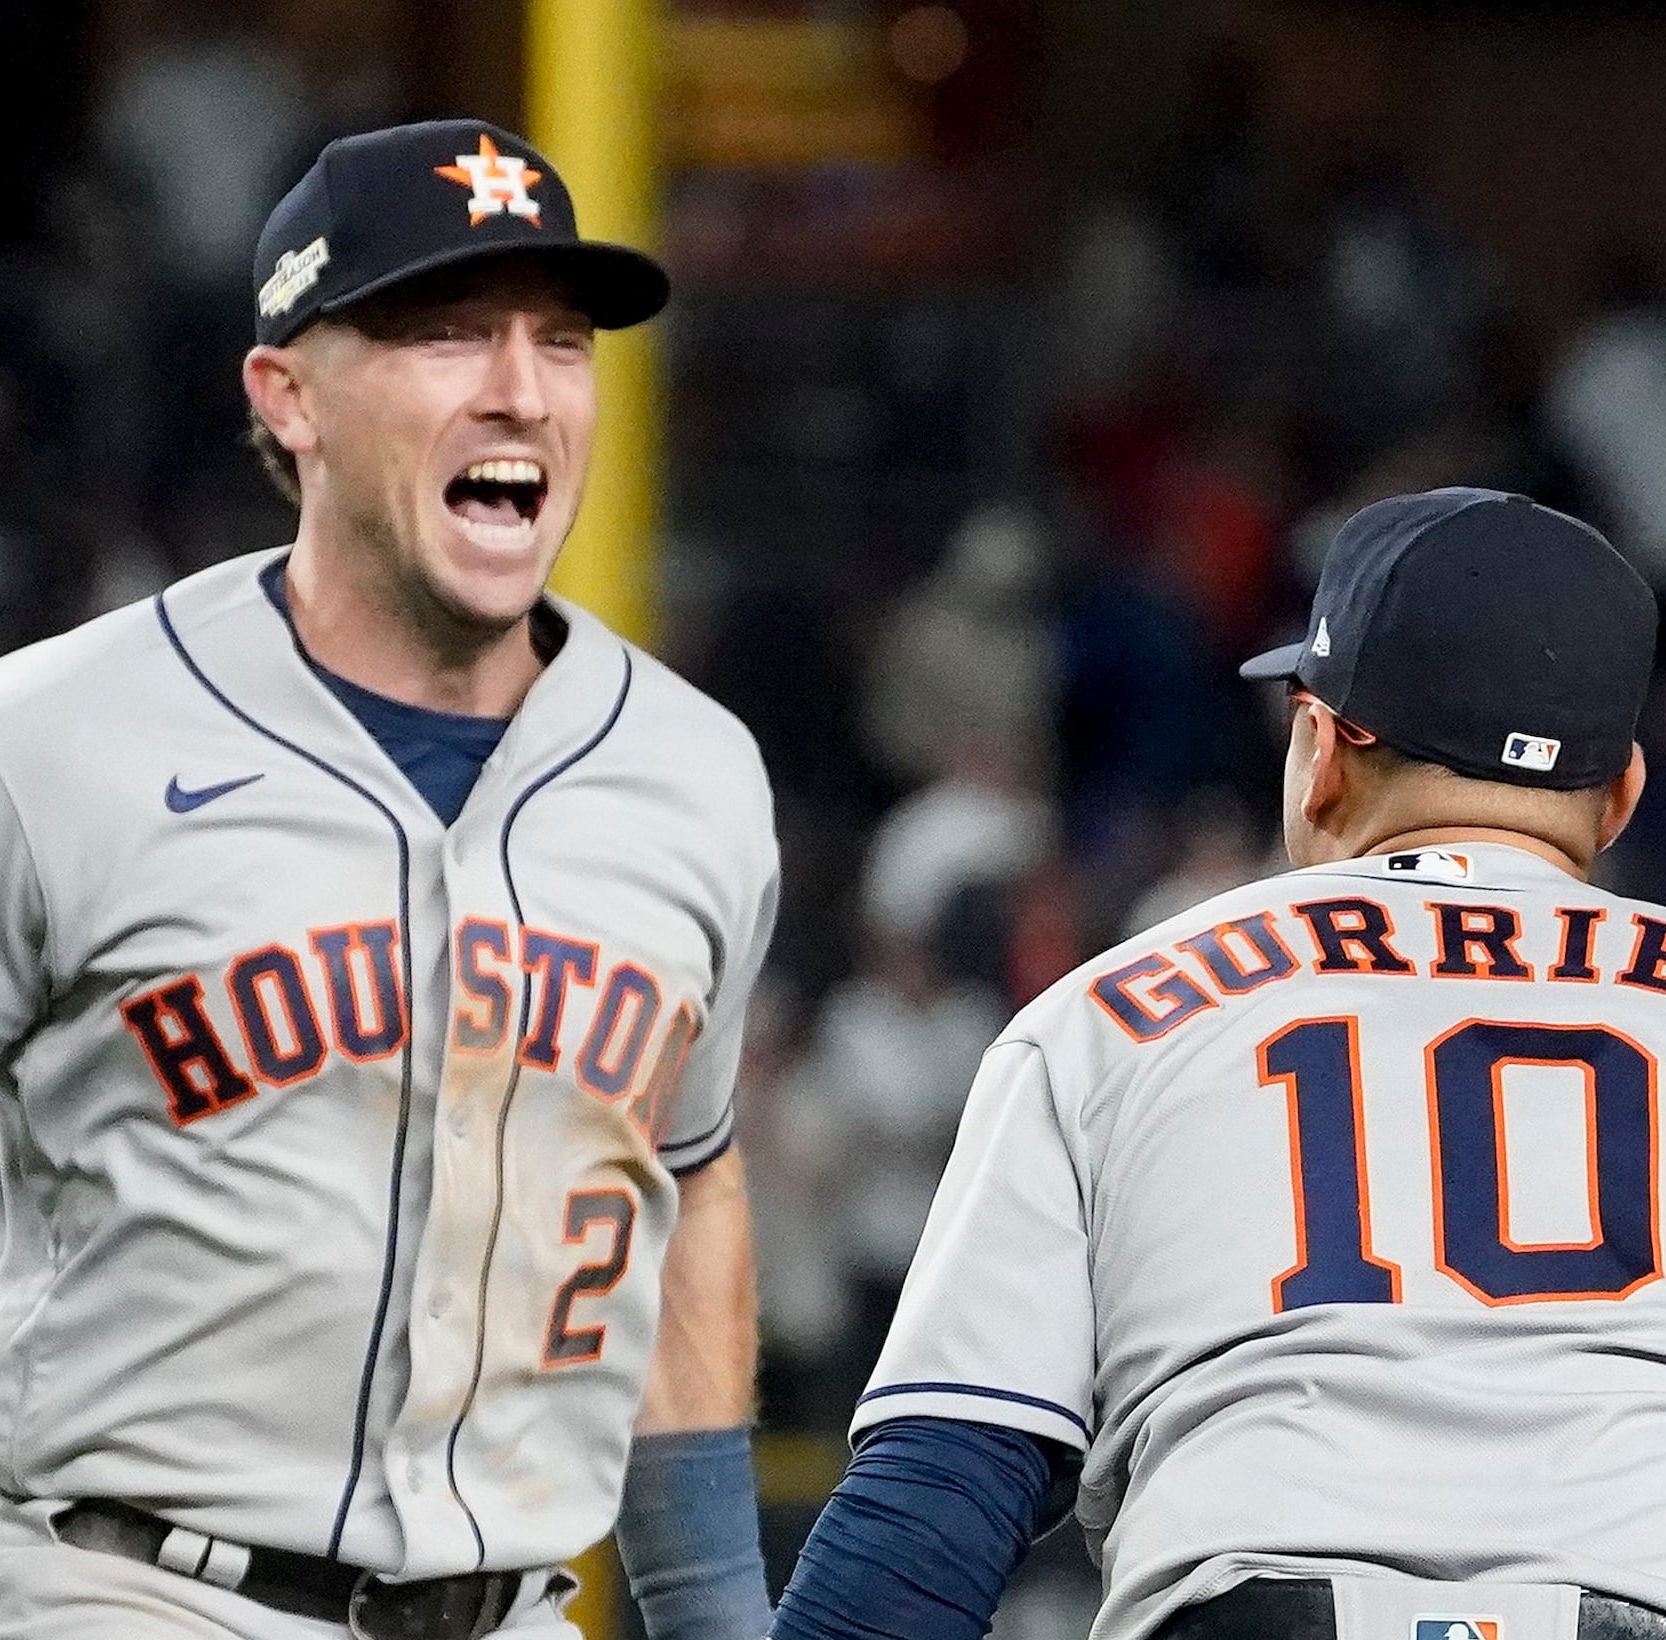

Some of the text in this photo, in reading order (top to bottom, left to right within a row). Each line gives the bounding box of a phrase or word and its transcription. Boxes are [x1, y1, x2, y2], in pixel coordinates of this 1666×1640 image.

[455, 154, 539, 215] H
[1255, 1014, 1665, 1315] 10
[539, 1186, 637, 1370] 2
